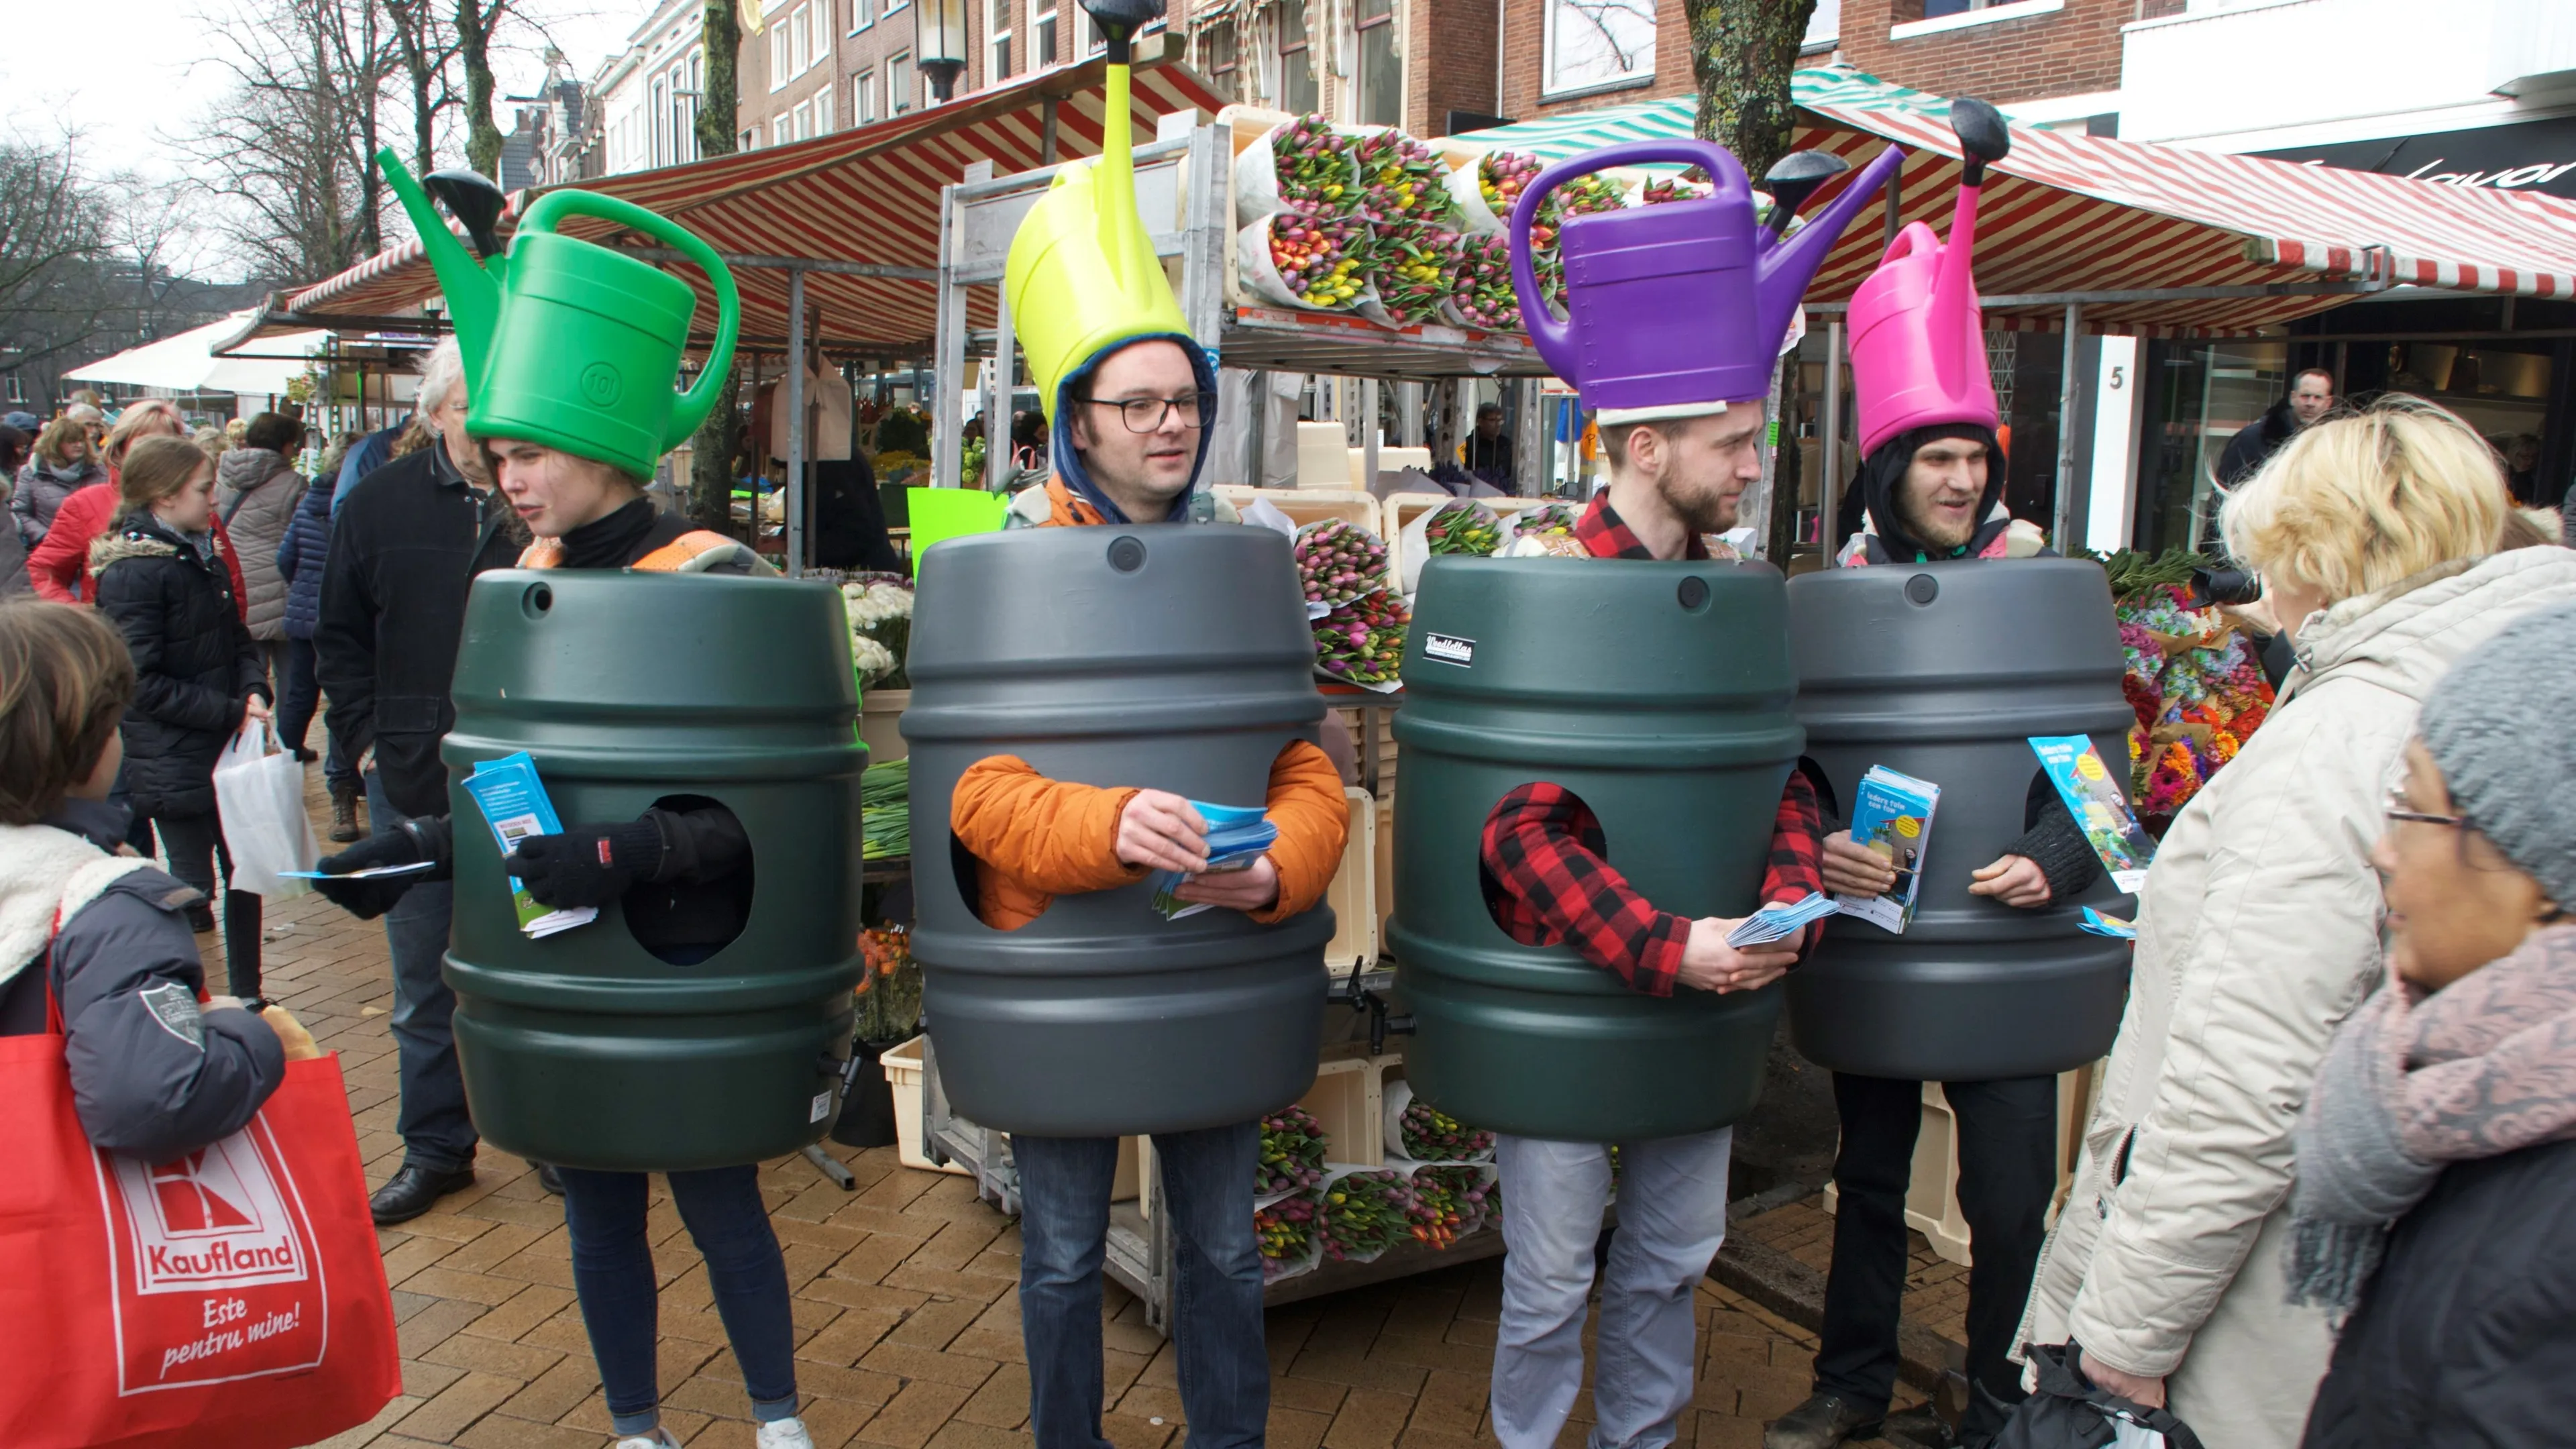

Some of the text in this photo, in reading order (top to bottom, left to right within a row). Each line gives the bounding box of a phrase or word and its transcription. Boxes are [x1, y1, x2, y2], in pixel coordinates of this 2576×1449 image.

[2109, 366, 2123, 390] 5
[148, 1236, 294, 1275] Kaufland
[203, 1297, 248, 1328] Este
[159, 1301, 300, 1380] pentru mine!
